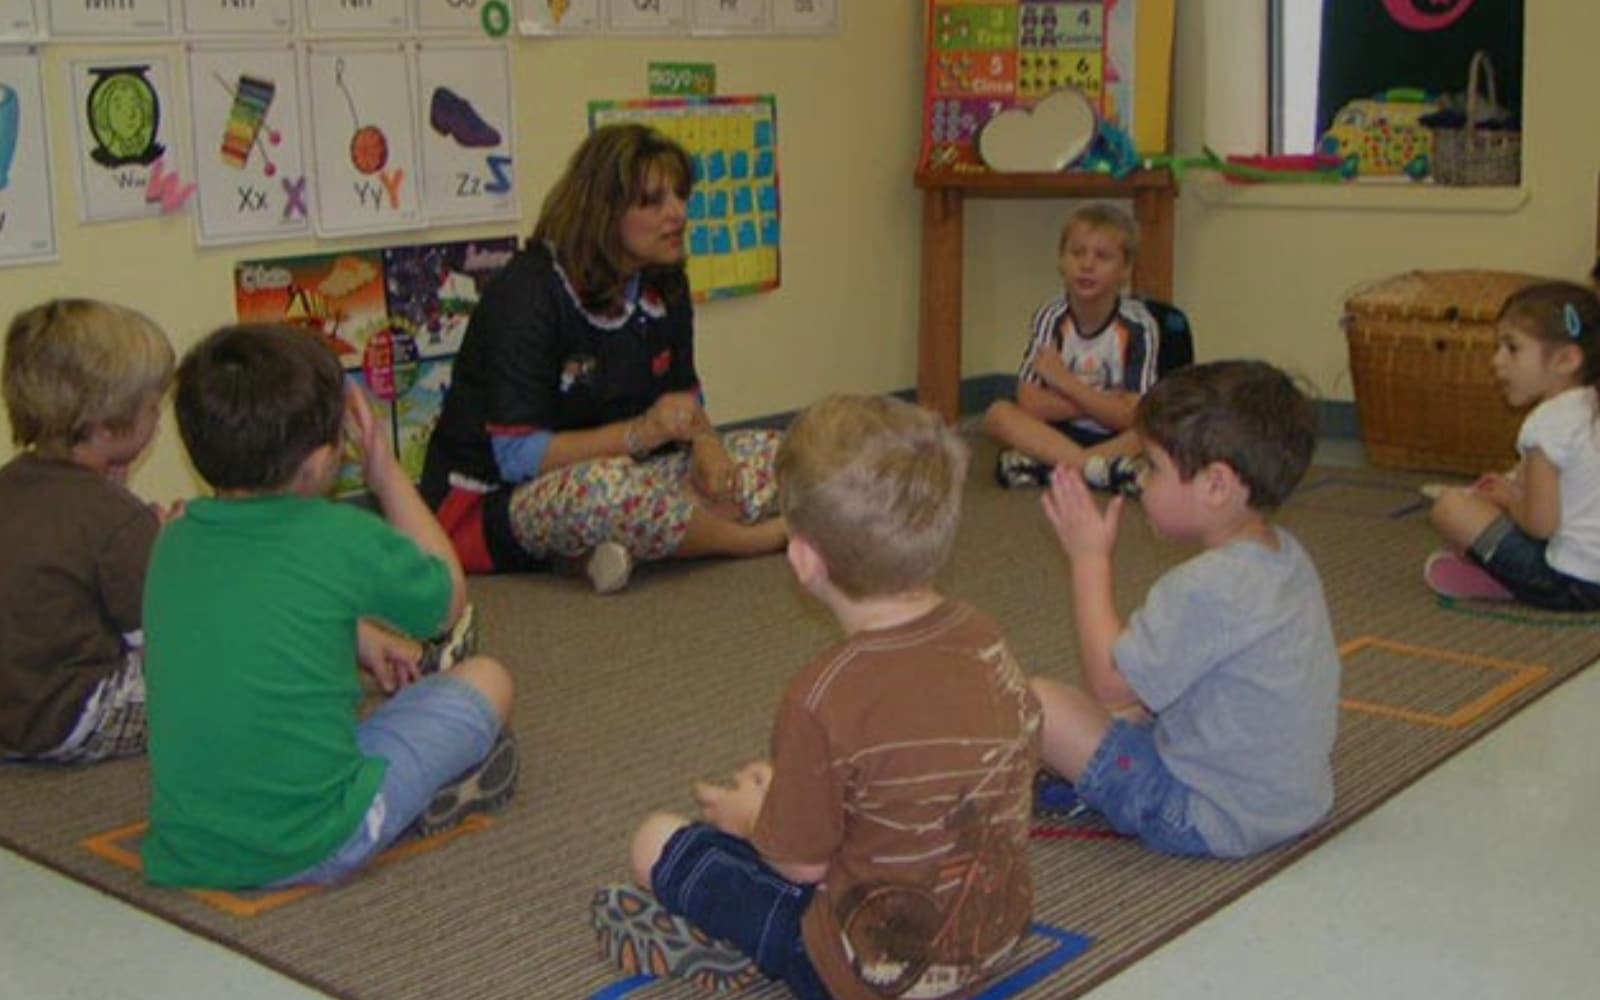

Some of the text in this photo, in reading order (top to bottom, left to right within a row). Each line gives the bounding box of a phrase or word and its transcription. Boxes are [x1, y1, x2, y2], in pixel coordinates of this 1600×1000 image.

[1076, 9, 1091, 27] 4
[1076, 57, 1090, 74] 6
[282, 176, 308, 219] X
[355, 182, 382, 210] Yy
[380, 168, 405, 210] Y
[456, 173, 481, 197] Zz
[238, 186, 268, 212] Xx
